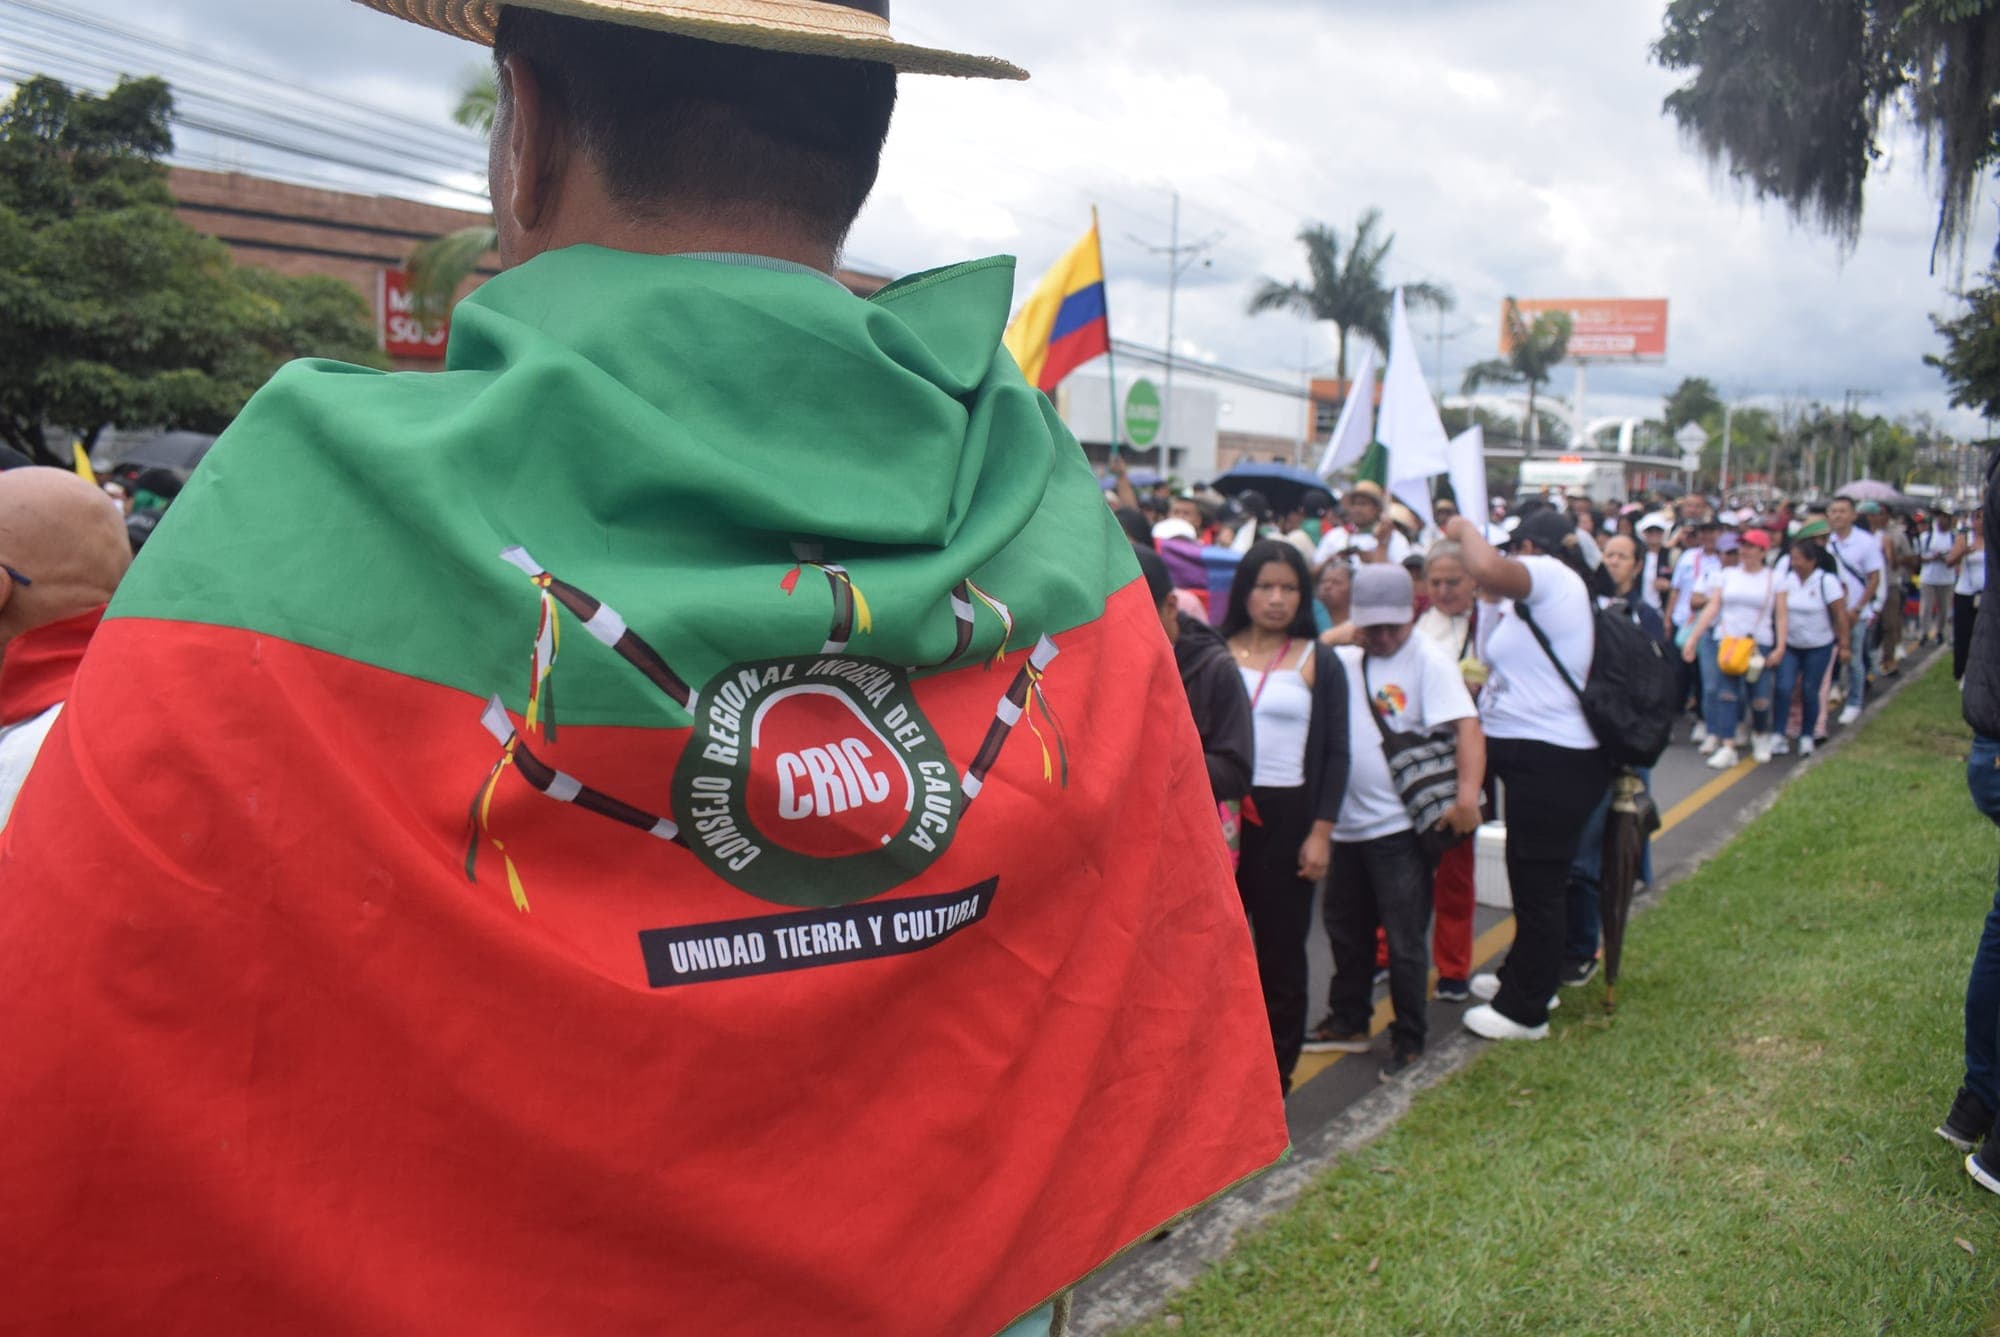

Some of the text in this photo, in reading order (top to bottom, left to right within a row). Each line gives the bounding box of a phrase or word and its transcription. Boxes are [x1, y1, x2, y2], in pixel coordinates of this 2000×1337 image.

[702, 664, 795, 766] REGIONAL
[883, 703, 926, 752] DEL
[776, 738, 889, 819] CRIC
[917, 760, 951, 852] CAUCA
[691, 776, 761, 871] CONSEJO
[668, 895, 980, 974] UNIDAD TIERRA Y CULTURA
